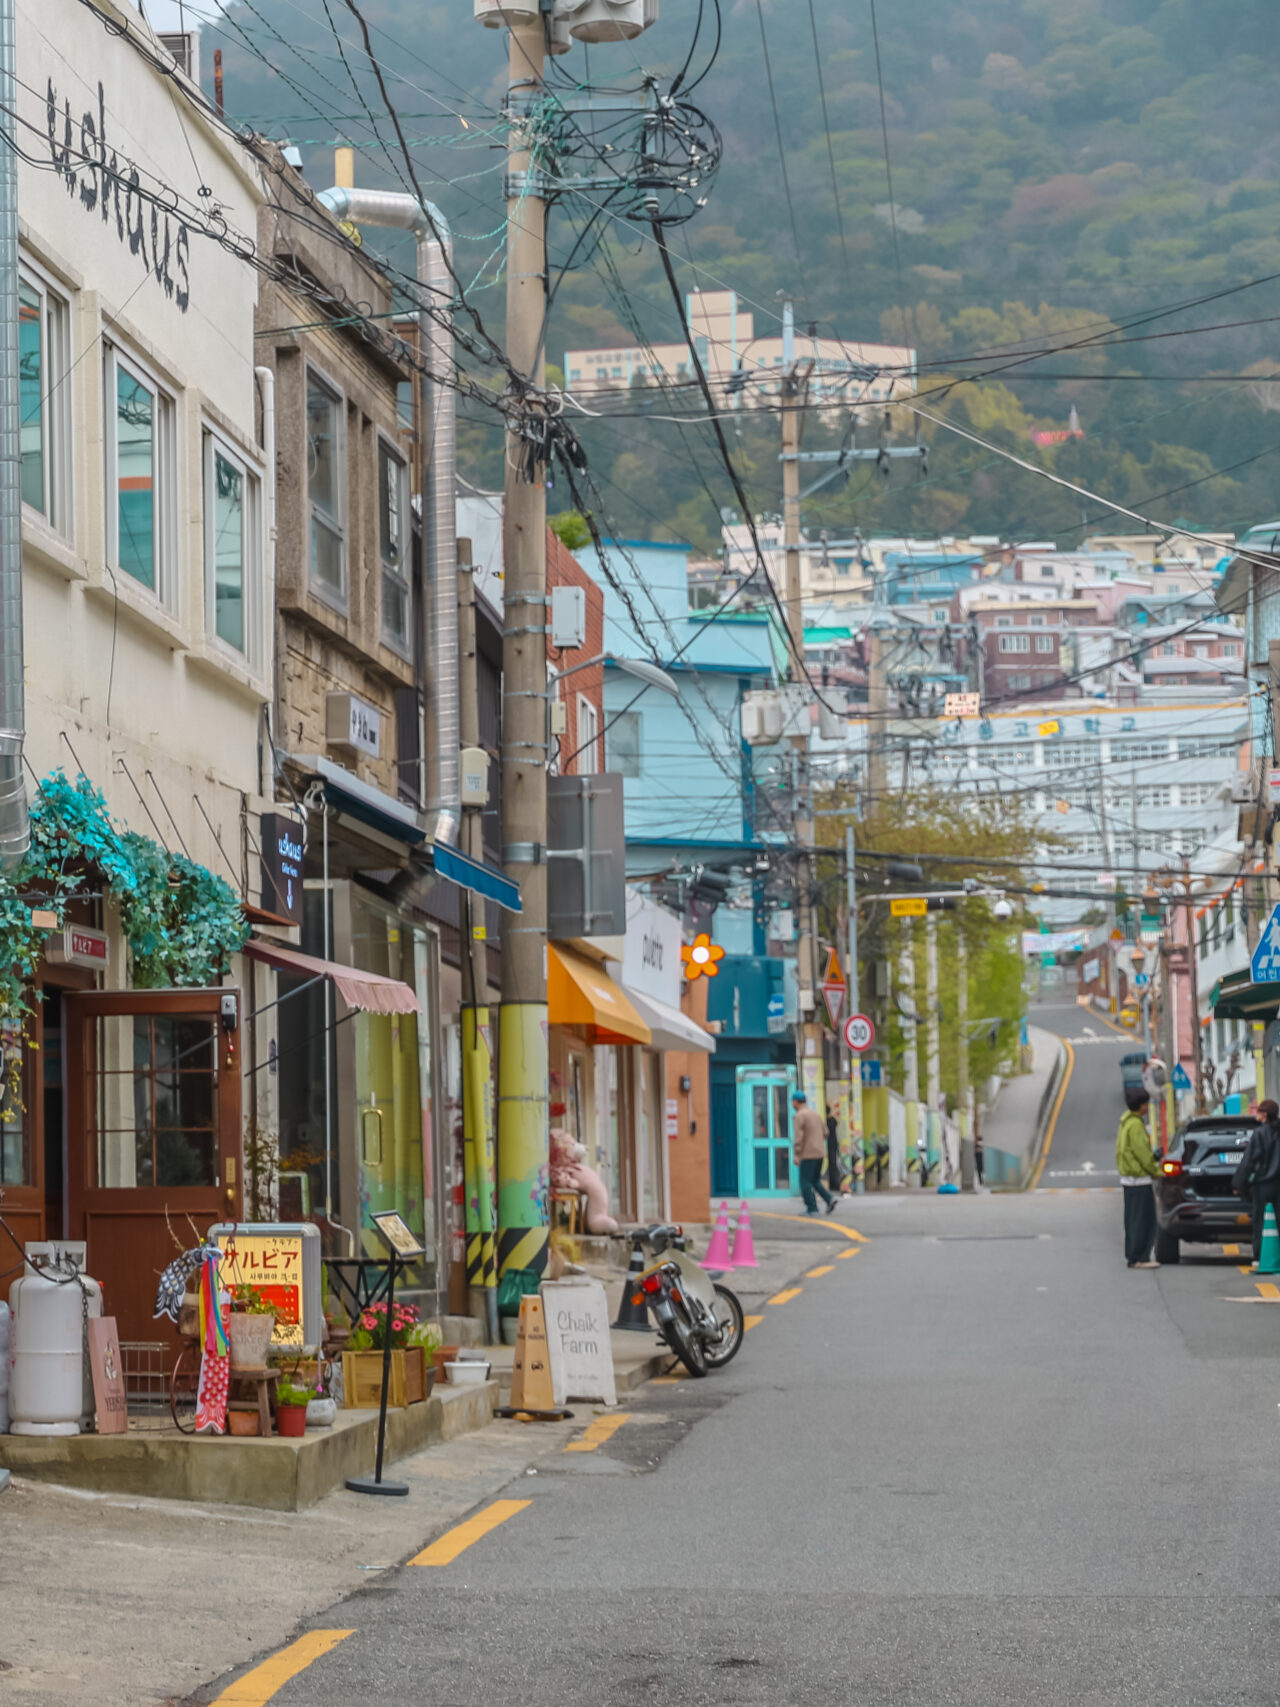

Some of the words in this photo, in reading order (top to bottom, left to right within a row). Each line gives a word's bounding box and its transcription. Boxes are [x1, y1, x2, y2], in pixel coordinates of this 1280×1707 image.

[851, 1025, 867, 1041] 30
[223, 1248, 298, 1269] サルビア
[557, 1310, 600, 1333] Chalk
[561, 1333, 599, 1354] Farm
